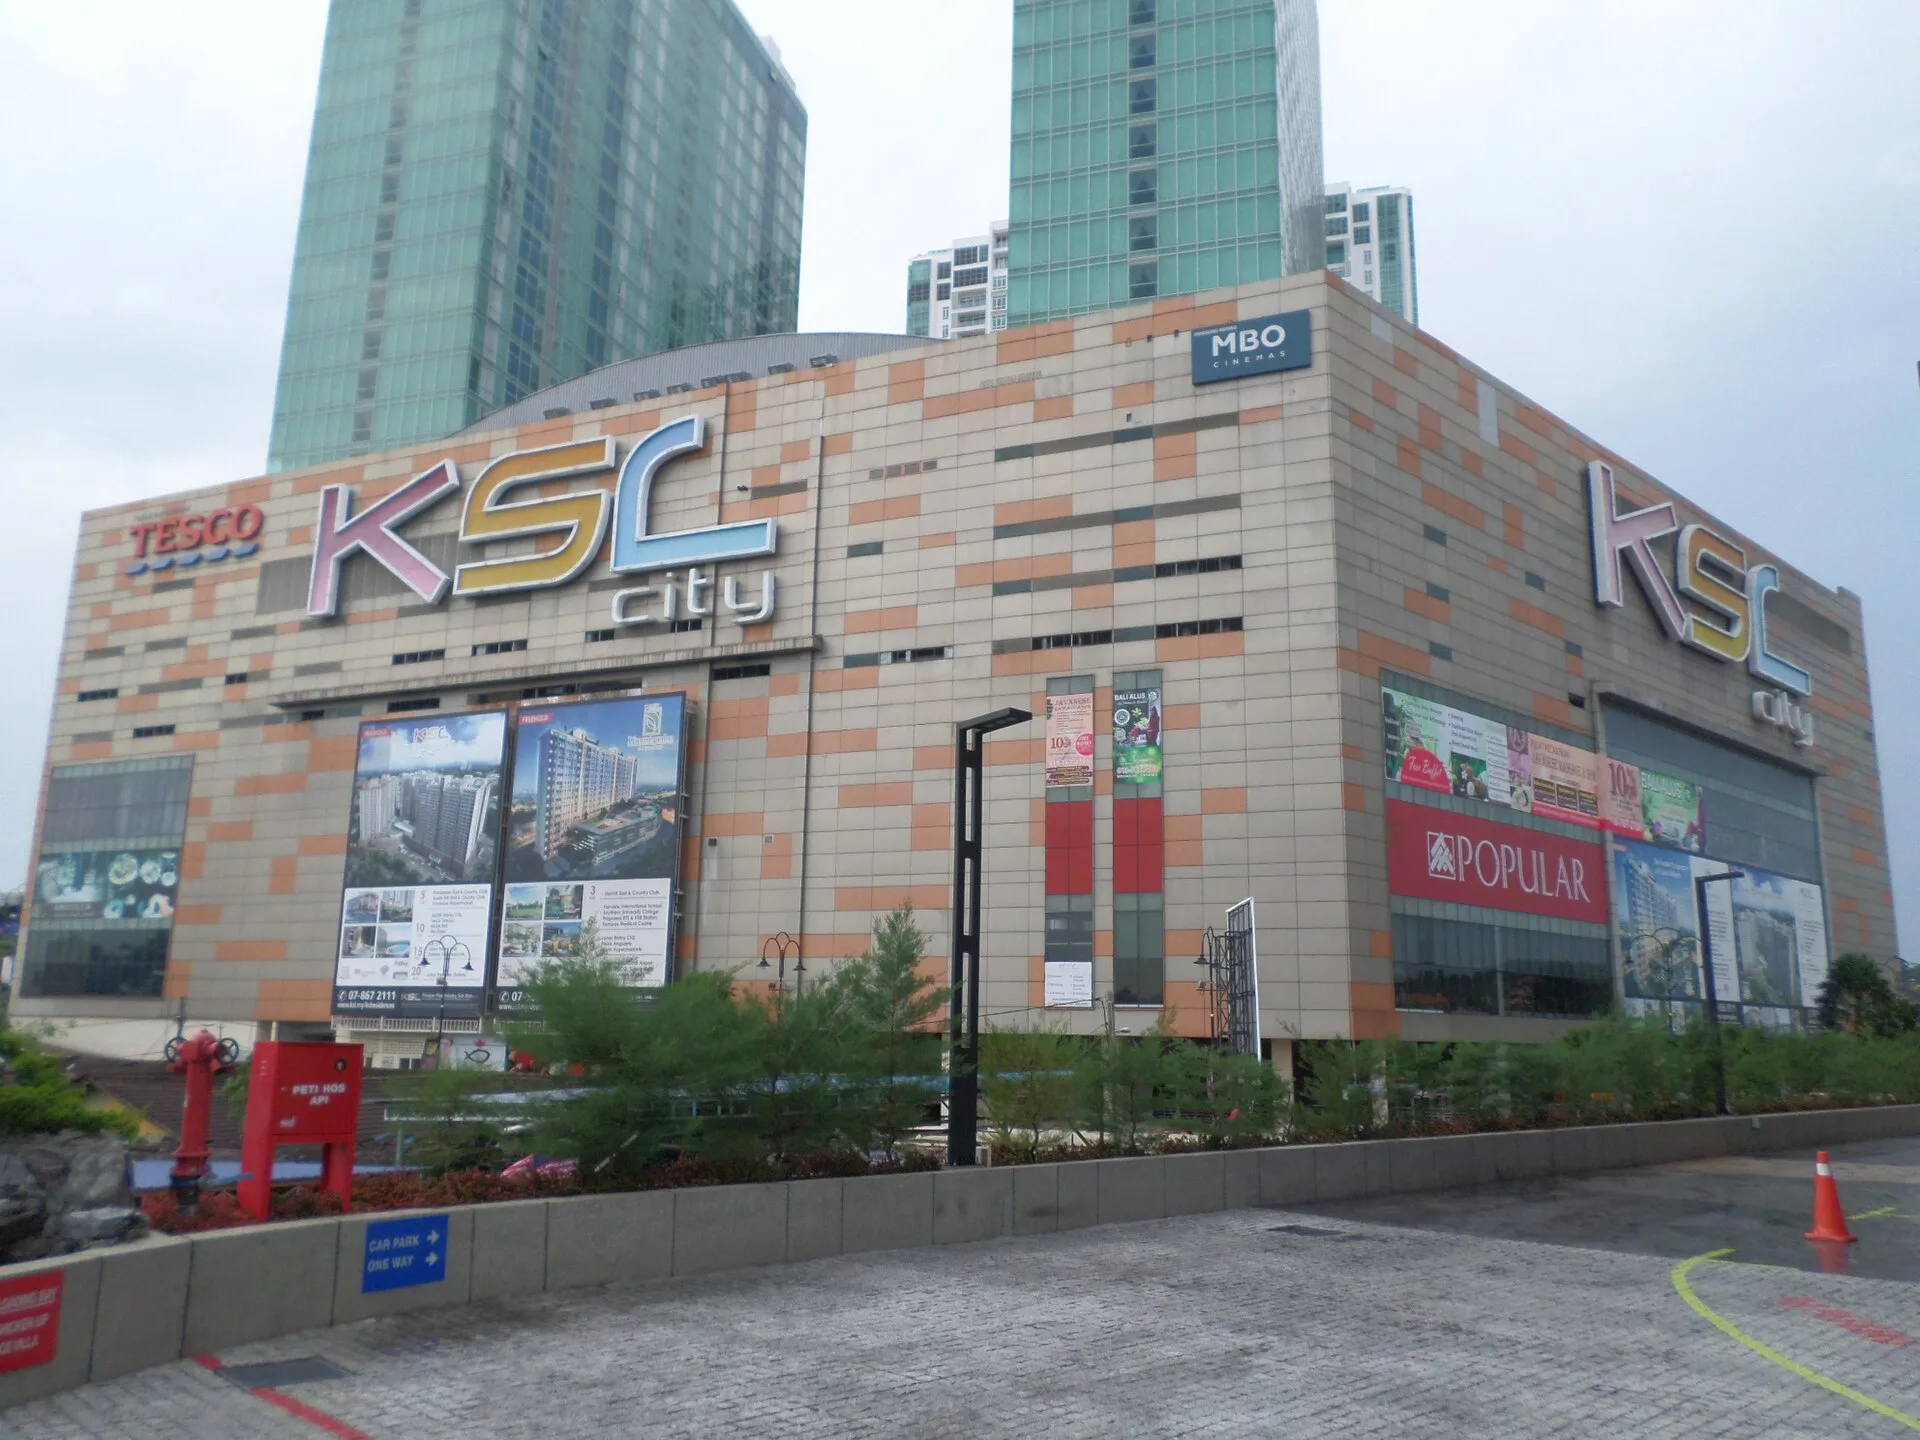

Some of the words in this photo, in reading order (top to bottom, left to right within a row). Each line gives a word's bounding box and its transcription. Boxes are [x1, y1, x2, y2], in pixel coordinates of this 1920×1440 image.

[1212, 324, 1286, 357] MBO
[1213, 350, 1286, 368] CINEMAS
[130, 504, 264, 558] TESCO
[612, 567, 775, 625] city
[1752, 689, 1814, 746] city
[1456, 835, 1591, 903] POPULAR
[590, 885, 596, 895] 3
[348, 990, 375, 1001] 07-867
[376, 990, 396, 1000] 2111
[292, 1084, 319, 1095] PETI
[323, 1083, 346, 1094] HOS
[309, 1095, 329, 1106] API
[368, 1238, 392, 1252] CAR
[392, 1234, 420, 1249] PARK
[367, 1260, 390, 1273] ONE
[391, 1254, 415, 1269] WAY
